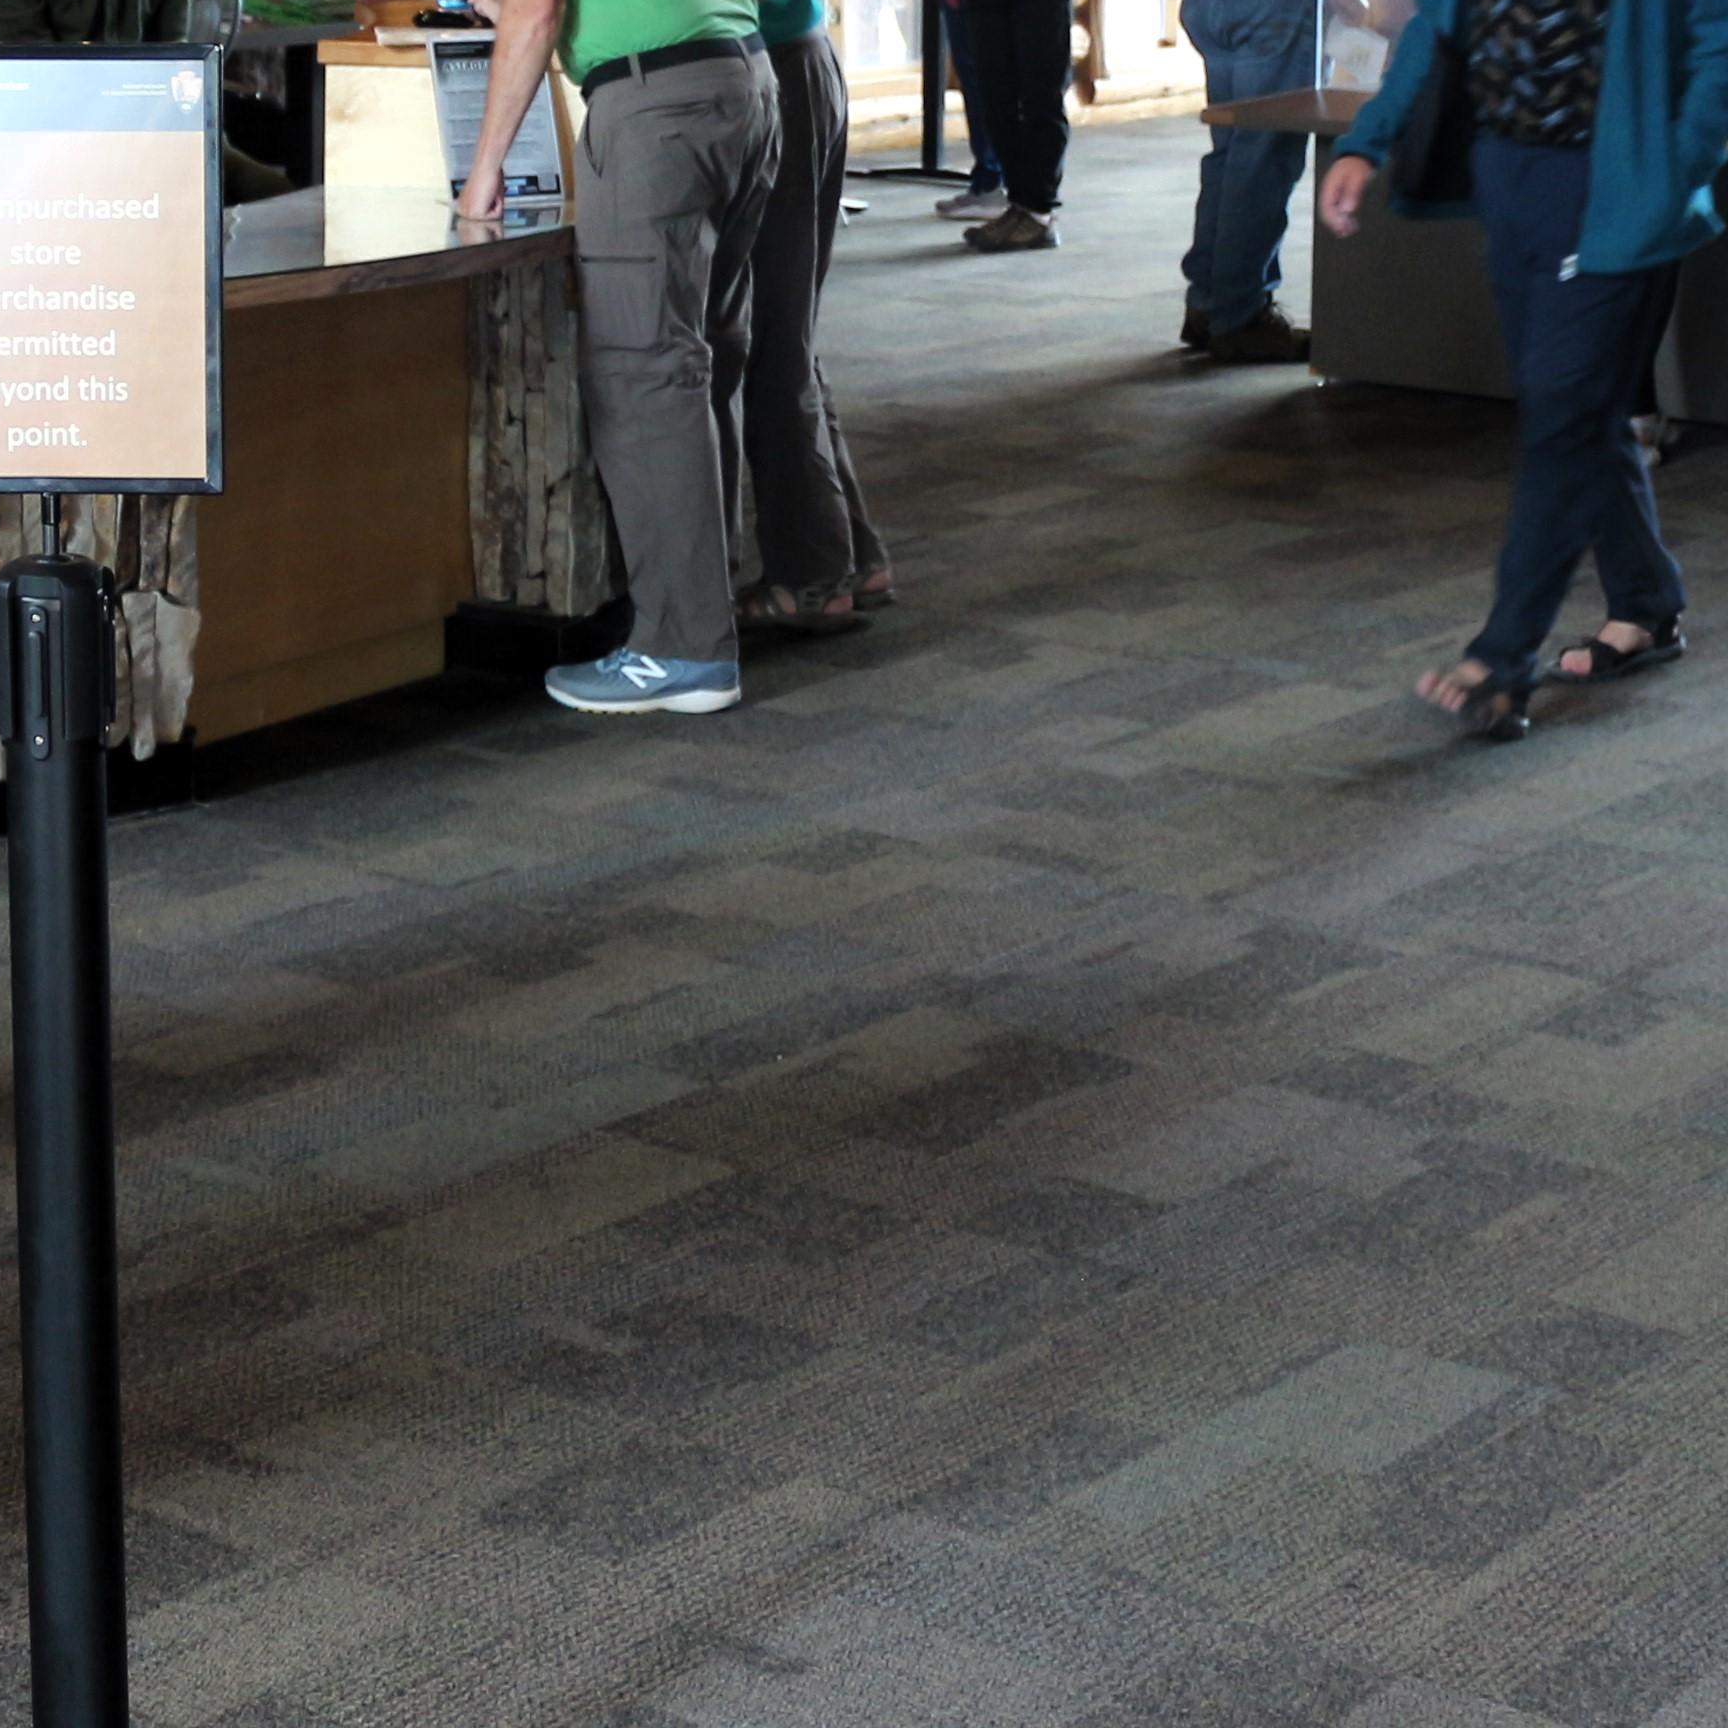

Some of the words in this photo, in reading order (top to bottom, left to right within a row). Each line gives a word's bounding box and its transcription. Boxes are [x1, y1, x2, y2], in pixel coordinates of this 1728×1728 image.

[10, 240, 81, 265] store
[78, 375, 128, 403] this
[7, 422, 88, 452] point.
